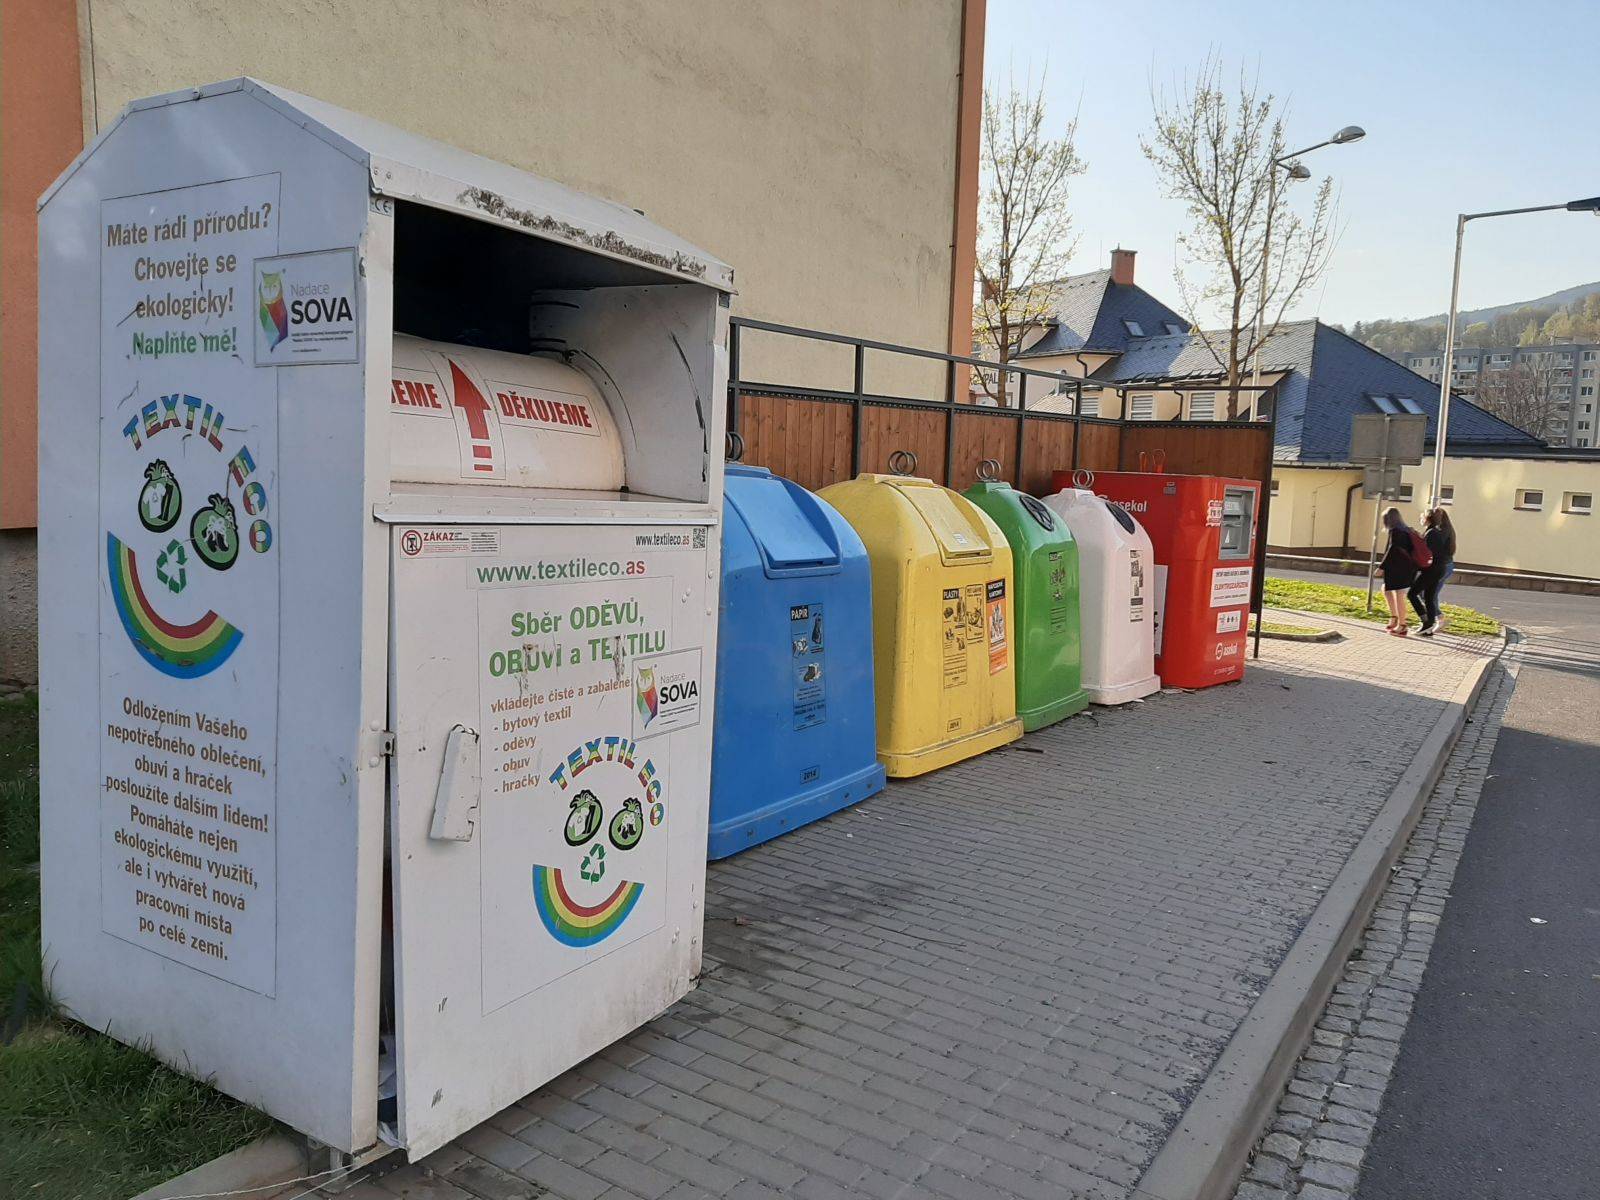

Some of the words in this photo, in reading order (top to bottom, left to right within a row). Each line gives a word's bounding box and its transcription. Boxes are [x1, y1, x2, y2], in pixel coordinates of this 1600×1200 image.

[107, 221, 147, 247] Máte
[154, 216, 187, 241] rádi
[193, 203, 272, 242] přírodu?
[135, 252, 209, 281] Chovejte
[216, 254, 236, 273] se
[291, 282, 330, 296] Nadace
[136, 288, 234, 320] ekologicky!
[291, 297, 353, 324] SOVA
[133, 329, 196, 359] Naplňte
[203, 327, 237, 351] mě!
[497, 390, 592, 428] DĚKUJEME
[423, 530, 454, 542] ZÁKAZ
[635, 533, 690, 546] www.textileco.as
[477, 559, 645, 584] www.textileco.as
[943, 590, 959, 599] PLASTY
[511, 611, 562, 637] Sběr
[570, 597, 644, 630] ODĚVŮ,
[570, 647, 581, 664] a
[659, 680, 698, 705] SOVA
[660, 672, 686, 685] Nadace
[491, 693, 544, 713] vkládejte
[548, 686, 574, 702] čisté
[578, 688, 584, 697] a
[123, 697, 191, 728] Odložením
[196, 712, 247, 740] Vašeho
[502, 714, 540, 732] bytový
[544, 706, 572, 723] textil
[108, 723, 195, 757] nepotřebného
[200, 743, 266, 777] oblečení,
[502, 735, 537, 753] oděvy
[135, 755, 168, 778] obuvi
[173, 768, 180, 781] a
[185, 766, 232, 794] hraček
[502, 756, 531, 773] obuv
[502, 773, 541, 793] hračky
[106, 775, 169, 805] posloužíte
[174, 791, 218, 819] dalším
[223, 803, 268, 832] lidem!
[130, 804, 194, 839] Pomáháte
[199, 829, 238, 853] nejen
[114, 828, 202, 870] ekologickému
[207, 860, 258, 889] využití,
[125, 858, 142, 876] ale
[155, 869, 207, 900] vytvářet
[212, 888, 245, 911] nová
[136, 889, 189, 920] pracovní
[194, 909, 232, 934] místa
[139, 916, 154, 933] po
[159, 924, 186, 945] celé
[190, 935, 228, 960] zemi.
